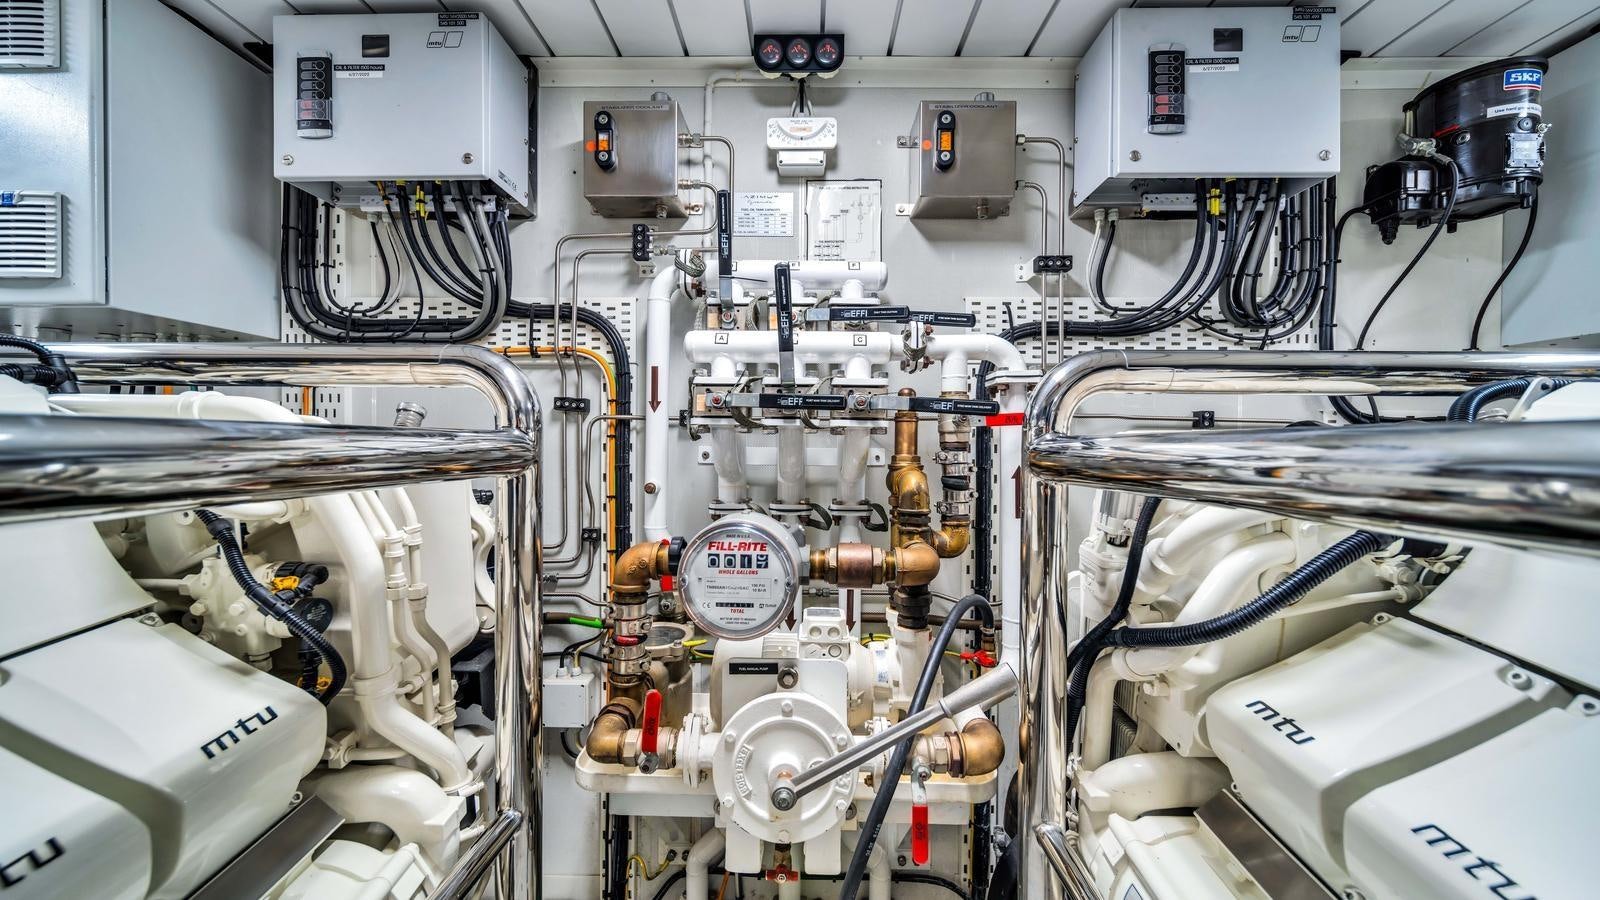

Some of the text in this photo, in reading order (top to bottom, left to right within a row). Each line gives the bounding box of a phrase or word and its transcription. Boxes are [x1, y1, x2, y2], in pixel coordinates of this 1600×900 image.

[1510, 72, 1540, 82] SKF
[200, 706, 278, 759] mtu
[1246, 700, 1316, 745] mtu
[0, 836, 65, 888] tu
[1411, 824, 1540, 900] mtu
